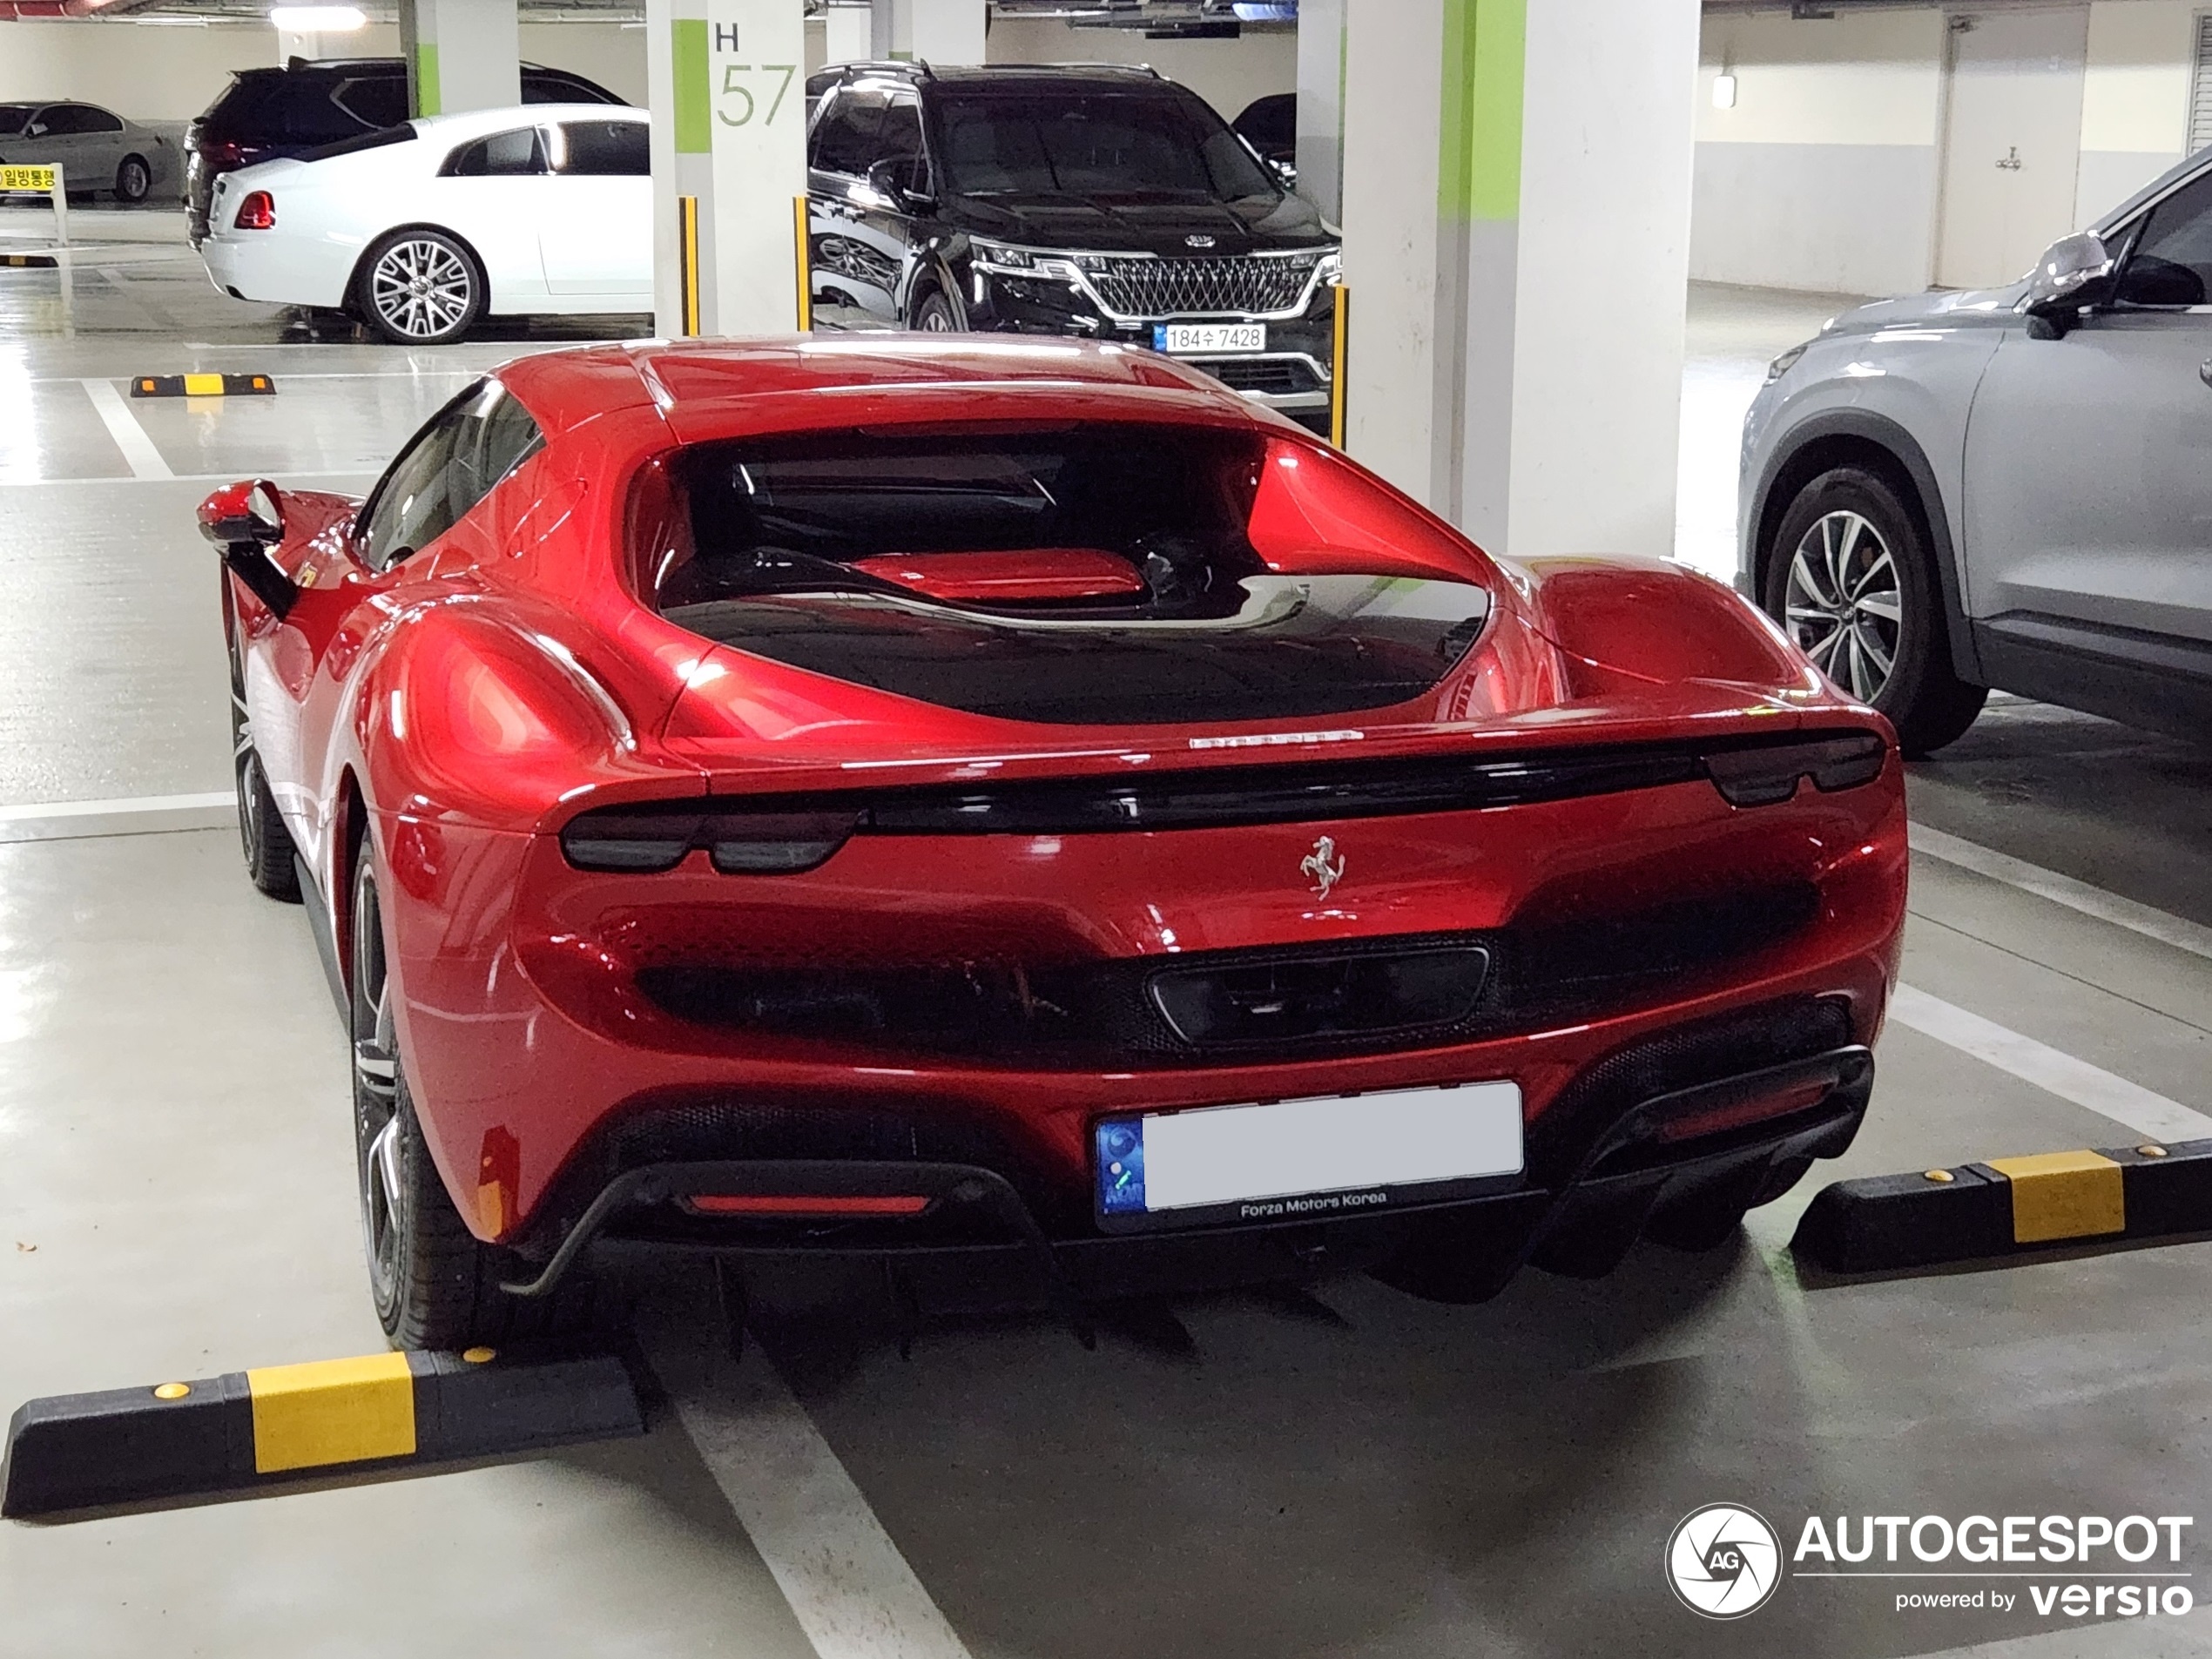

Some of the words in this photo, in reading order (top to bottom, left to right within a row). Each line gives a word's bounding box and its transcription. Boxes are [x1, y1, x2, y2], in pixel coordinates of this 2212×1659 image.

[716, 23, 738, 52] H
[718, 64, 797, 127] 57
[4, 170, 55, 186] 일방통행
[1170, 330, 1213, 347] 184수
[1219, 329, 1260, 347] 7428
[1241, 1203, 1283, 1217] Forza
[1286, 1197, 1340, 1212] Motors
[1342, 1192, 1387, 1207] Korea
